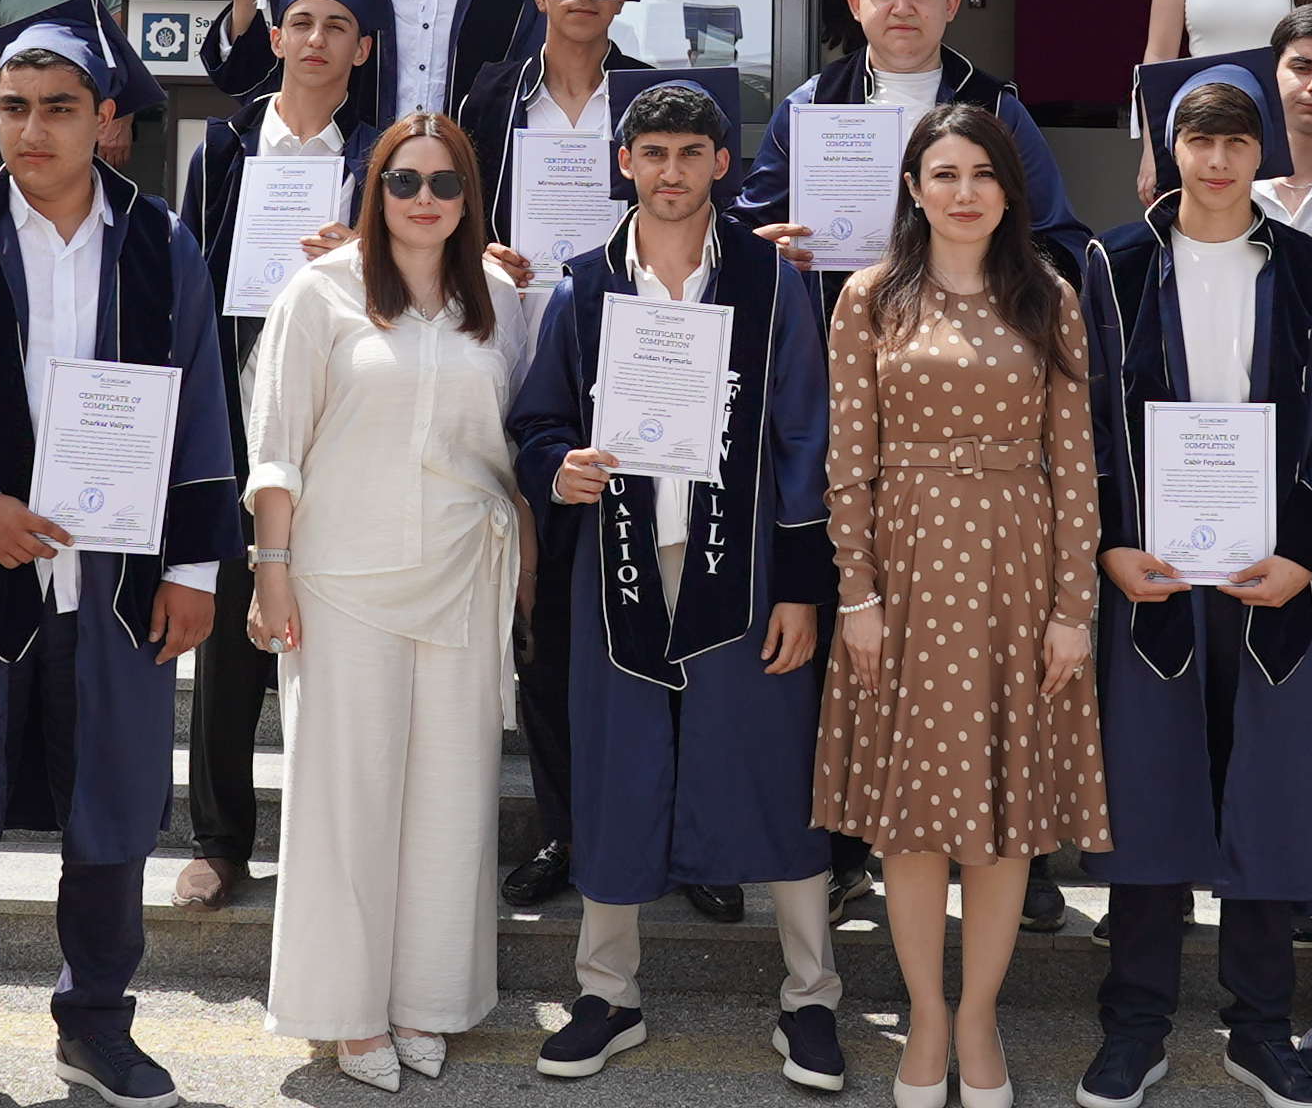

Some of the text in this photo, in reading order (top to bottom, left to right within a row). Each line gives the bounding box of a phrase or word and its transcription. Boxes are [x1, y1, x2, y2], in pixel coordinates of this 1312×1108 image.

[635, 327, 685, 339] CERTIFICATE
[639, 337, 689, 348] COMPLETION
[79, 392, 130, 403] CERTIFICATE
[82, 402, 135, 412] COMPLETION
[1179, 433, 1229, 441] CERTIFICATE
[609, 477, 640, 606] UATION
